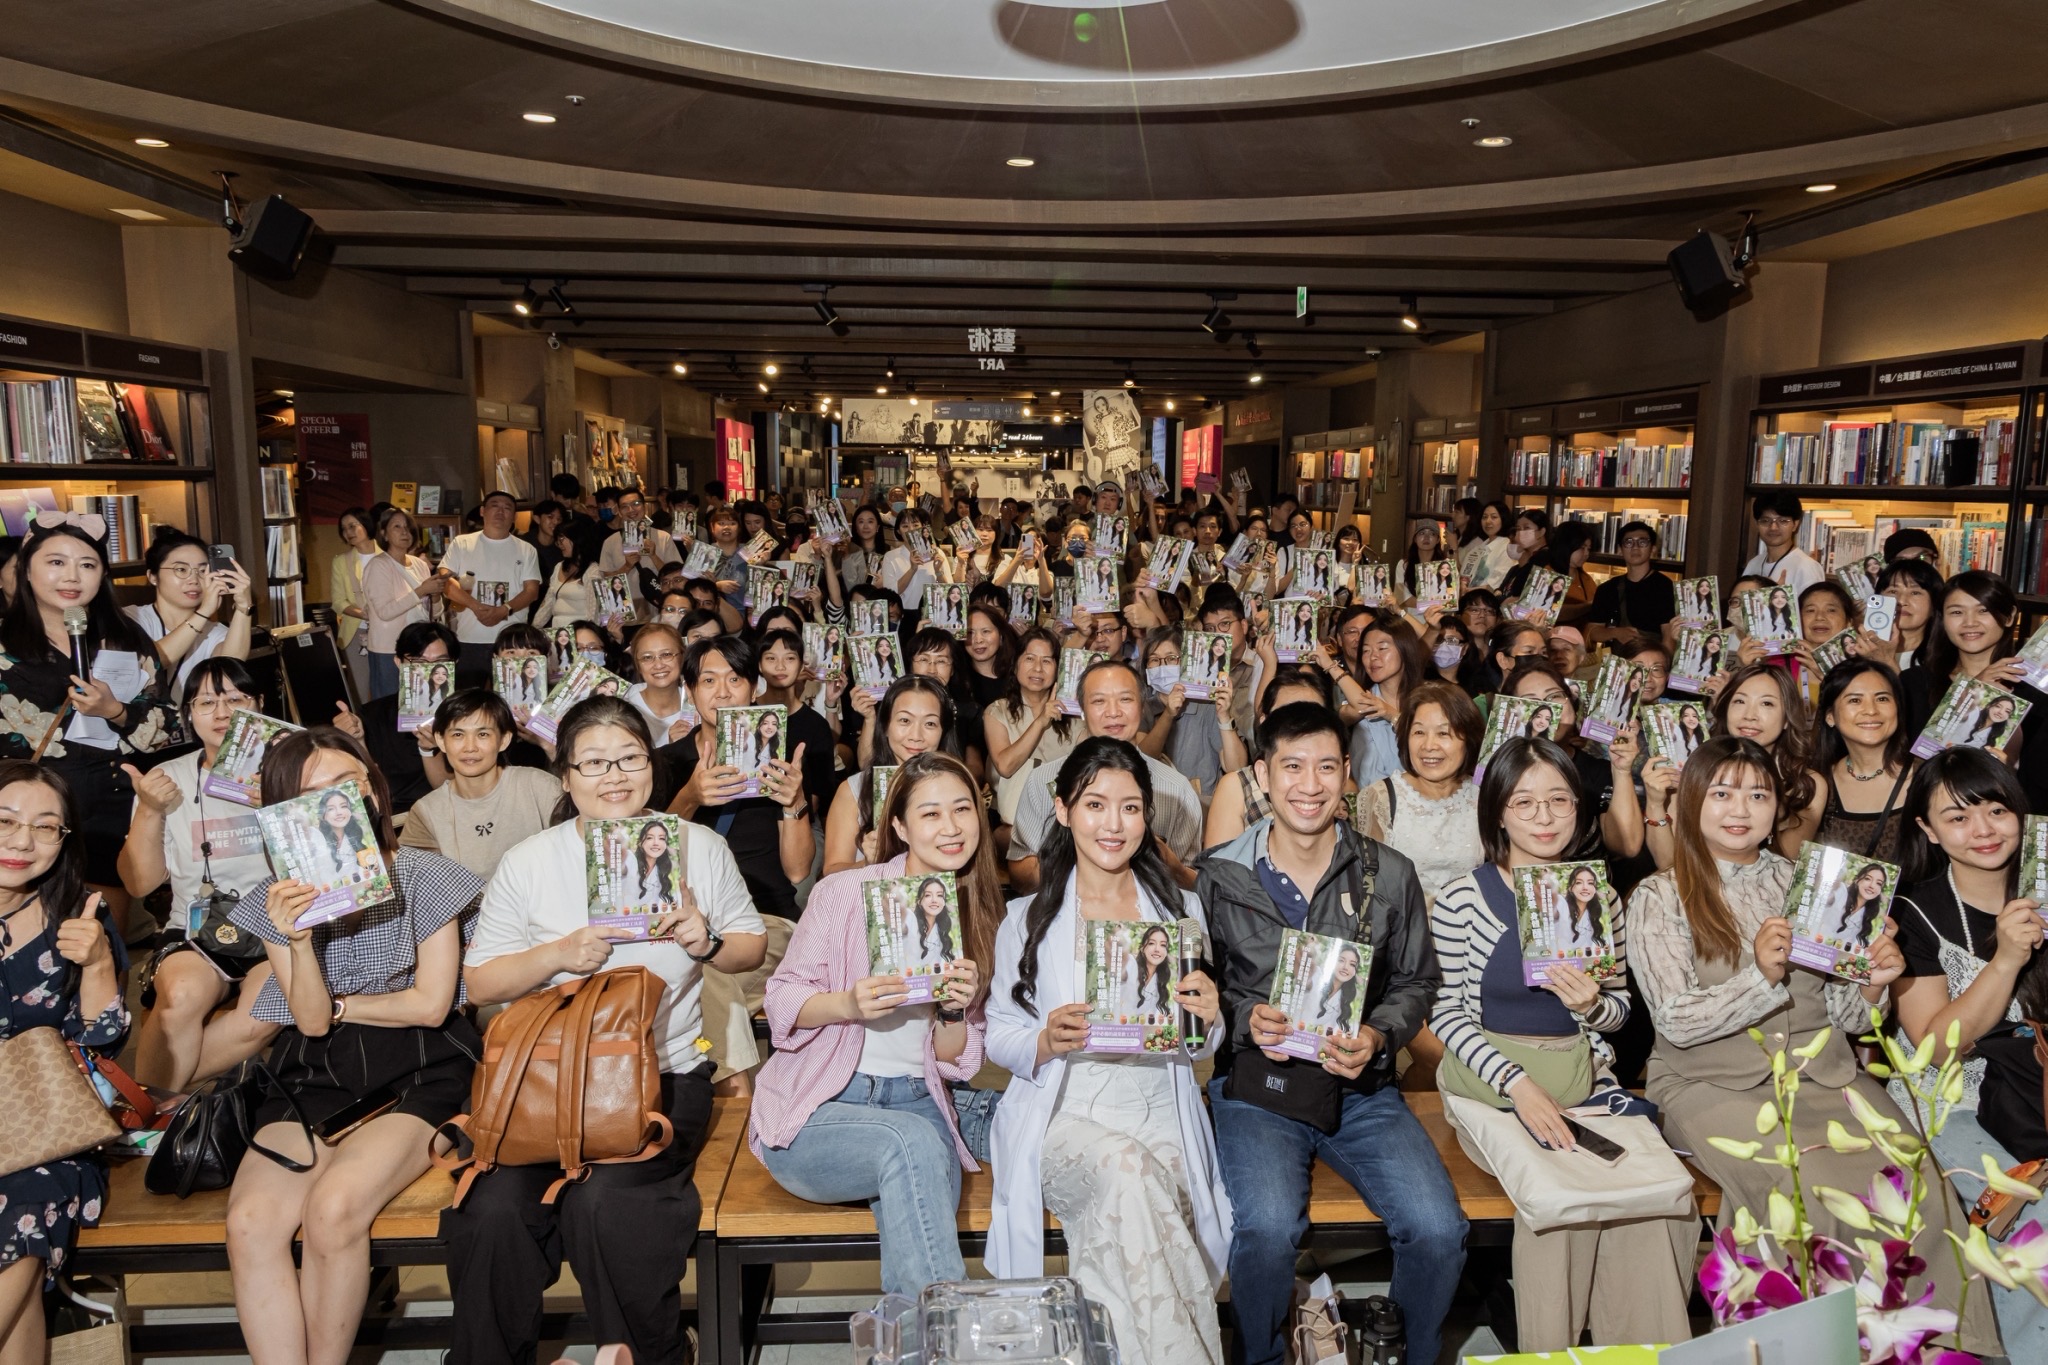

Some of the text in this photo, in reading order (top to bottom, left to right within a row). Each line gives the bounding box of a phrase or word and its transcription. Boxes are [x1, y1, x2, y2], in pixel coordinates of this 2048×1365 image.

[138, 354, 160, 364] FASHION
[1922, 366, 1961, 378] ARCHITECTURE
[1962, 365, 1969, 374] OF
[1970, 364, 1988, 373] CHINA
[1988, 363, 1994, 371] &
[1994, 361, 2017, 370] TAIWAN
[300, 416, 337, 424] SPECIAL
[301, 426, 332, 434] OFFER
